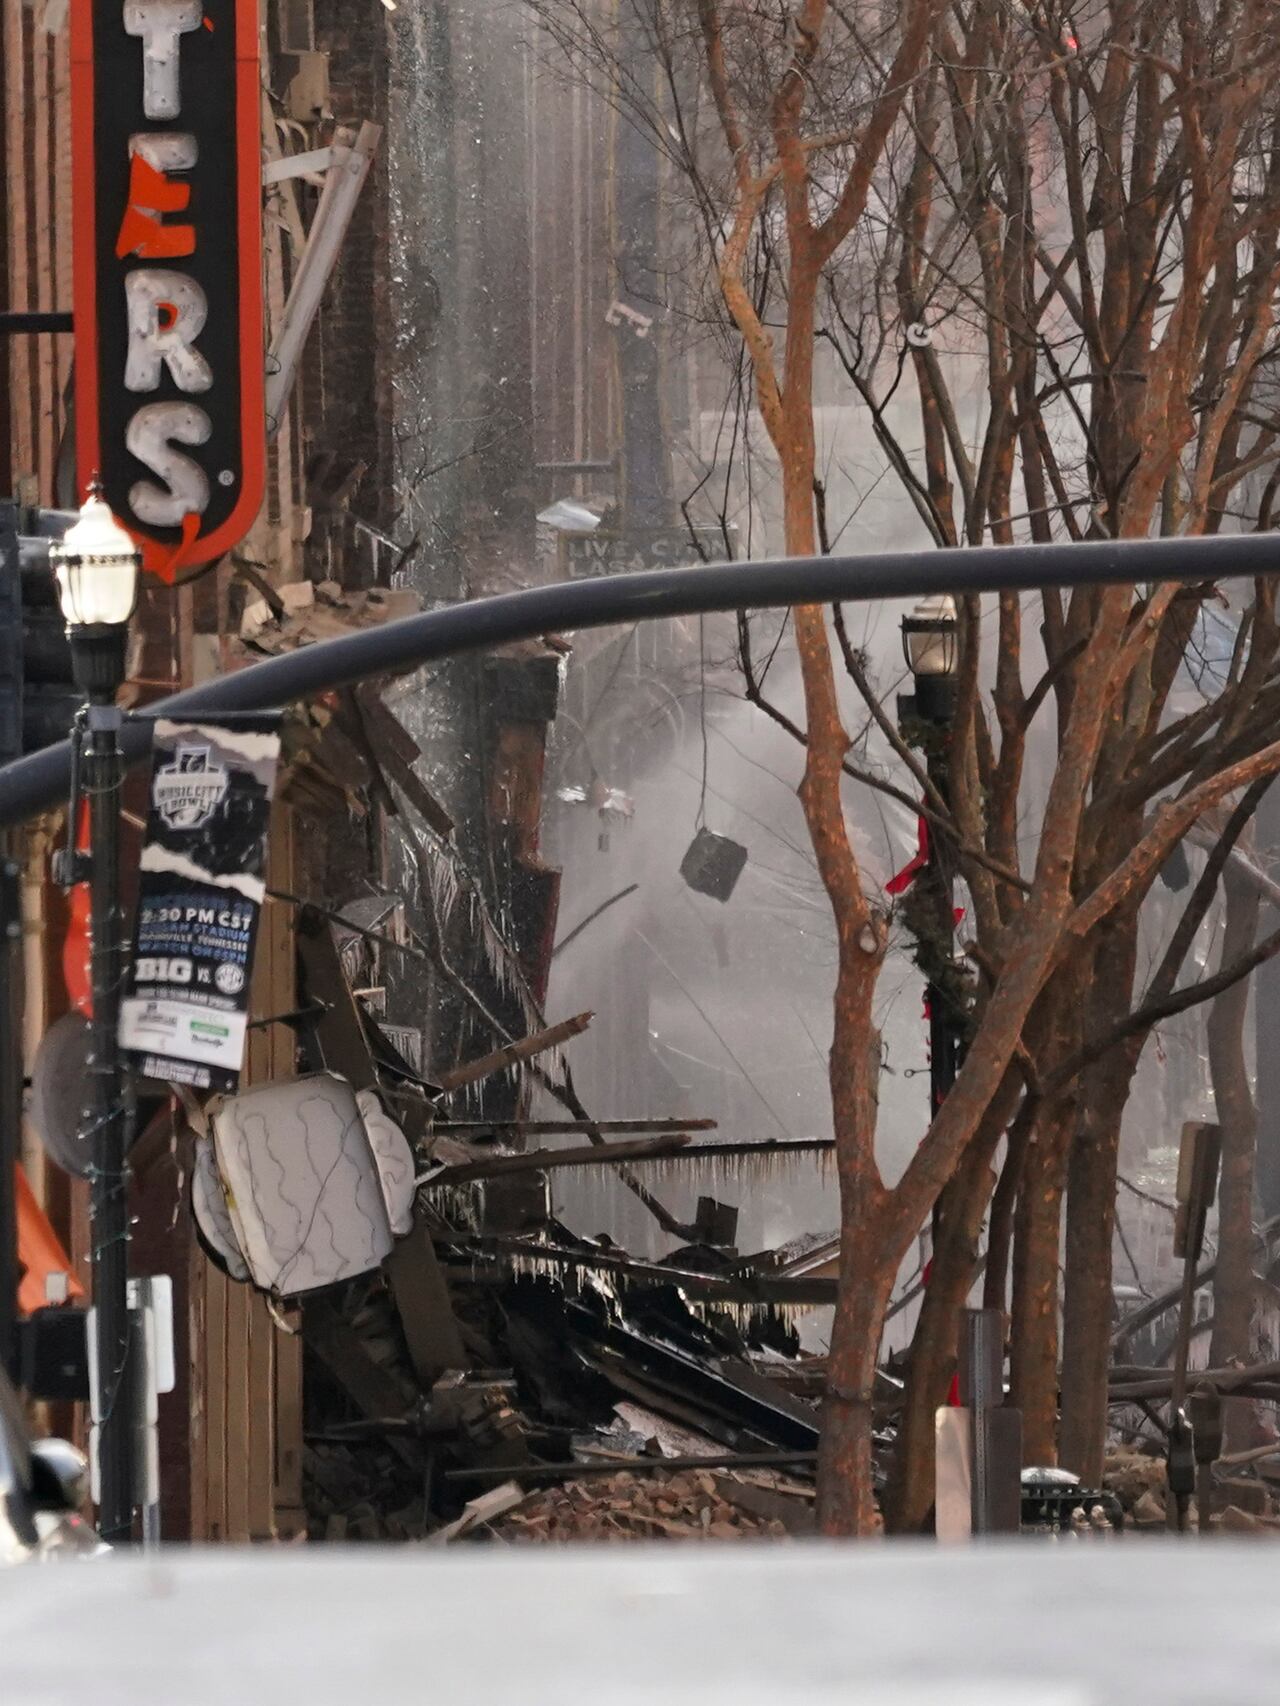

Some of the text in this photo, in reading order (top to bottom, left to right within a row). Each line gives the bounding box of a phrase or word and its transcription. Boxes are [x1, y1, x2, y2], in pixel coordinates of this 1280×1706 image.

[185, 907, 216, 925] PM
[218, 909, 252, 931] CST
[193, 923, 251, 942] STADIUM
